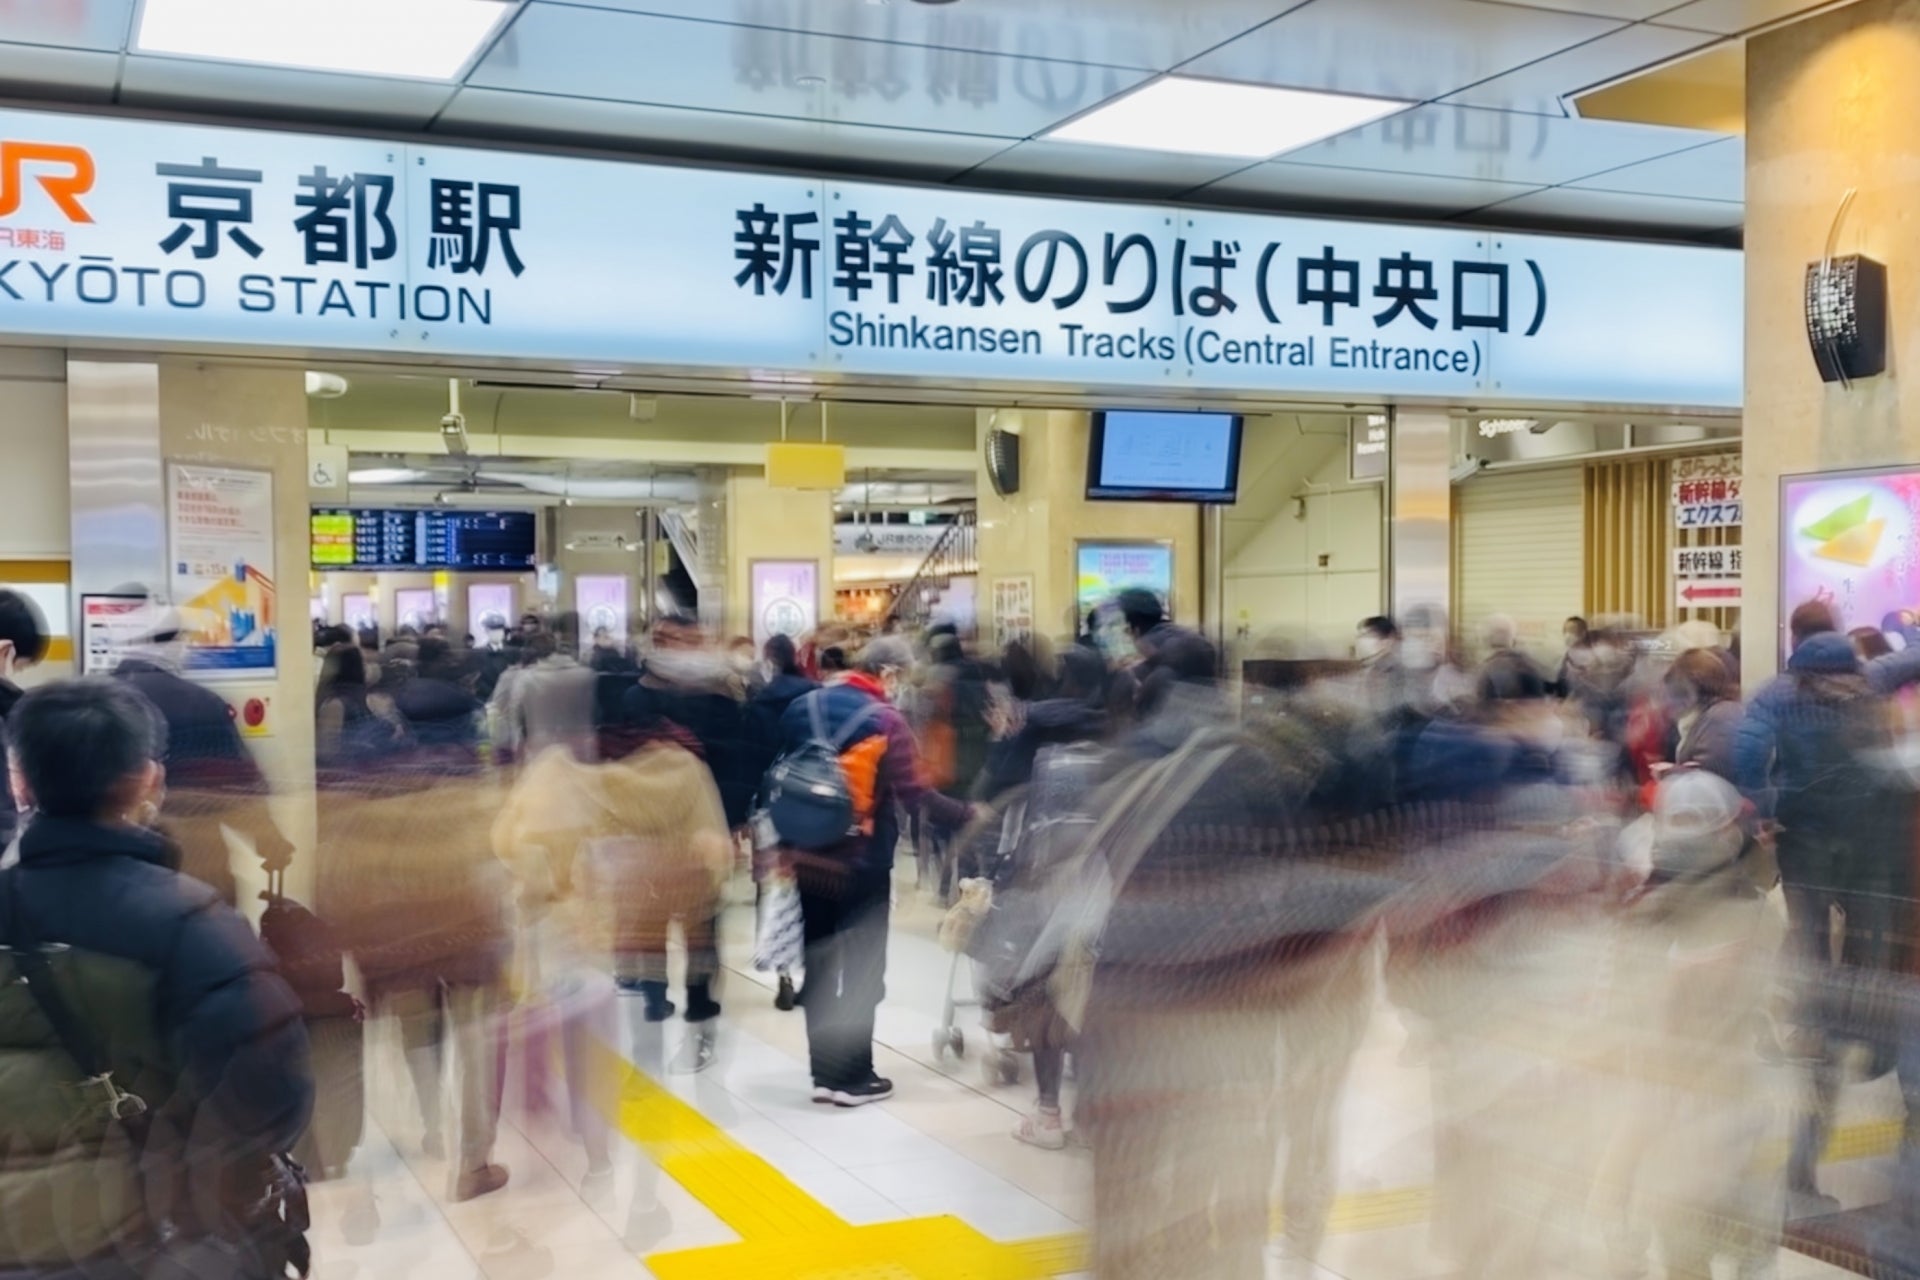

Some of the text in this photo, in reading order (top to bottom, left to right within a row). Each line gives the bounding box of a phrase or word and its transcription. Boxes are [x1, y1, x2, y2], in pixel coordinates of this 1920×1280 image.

[156, 156, 526, 278] 京都駅
[239, 273, 491, 325] STATION
[829, 310, 1482, 377] Shinkansen Tracks (Central Entrance)
